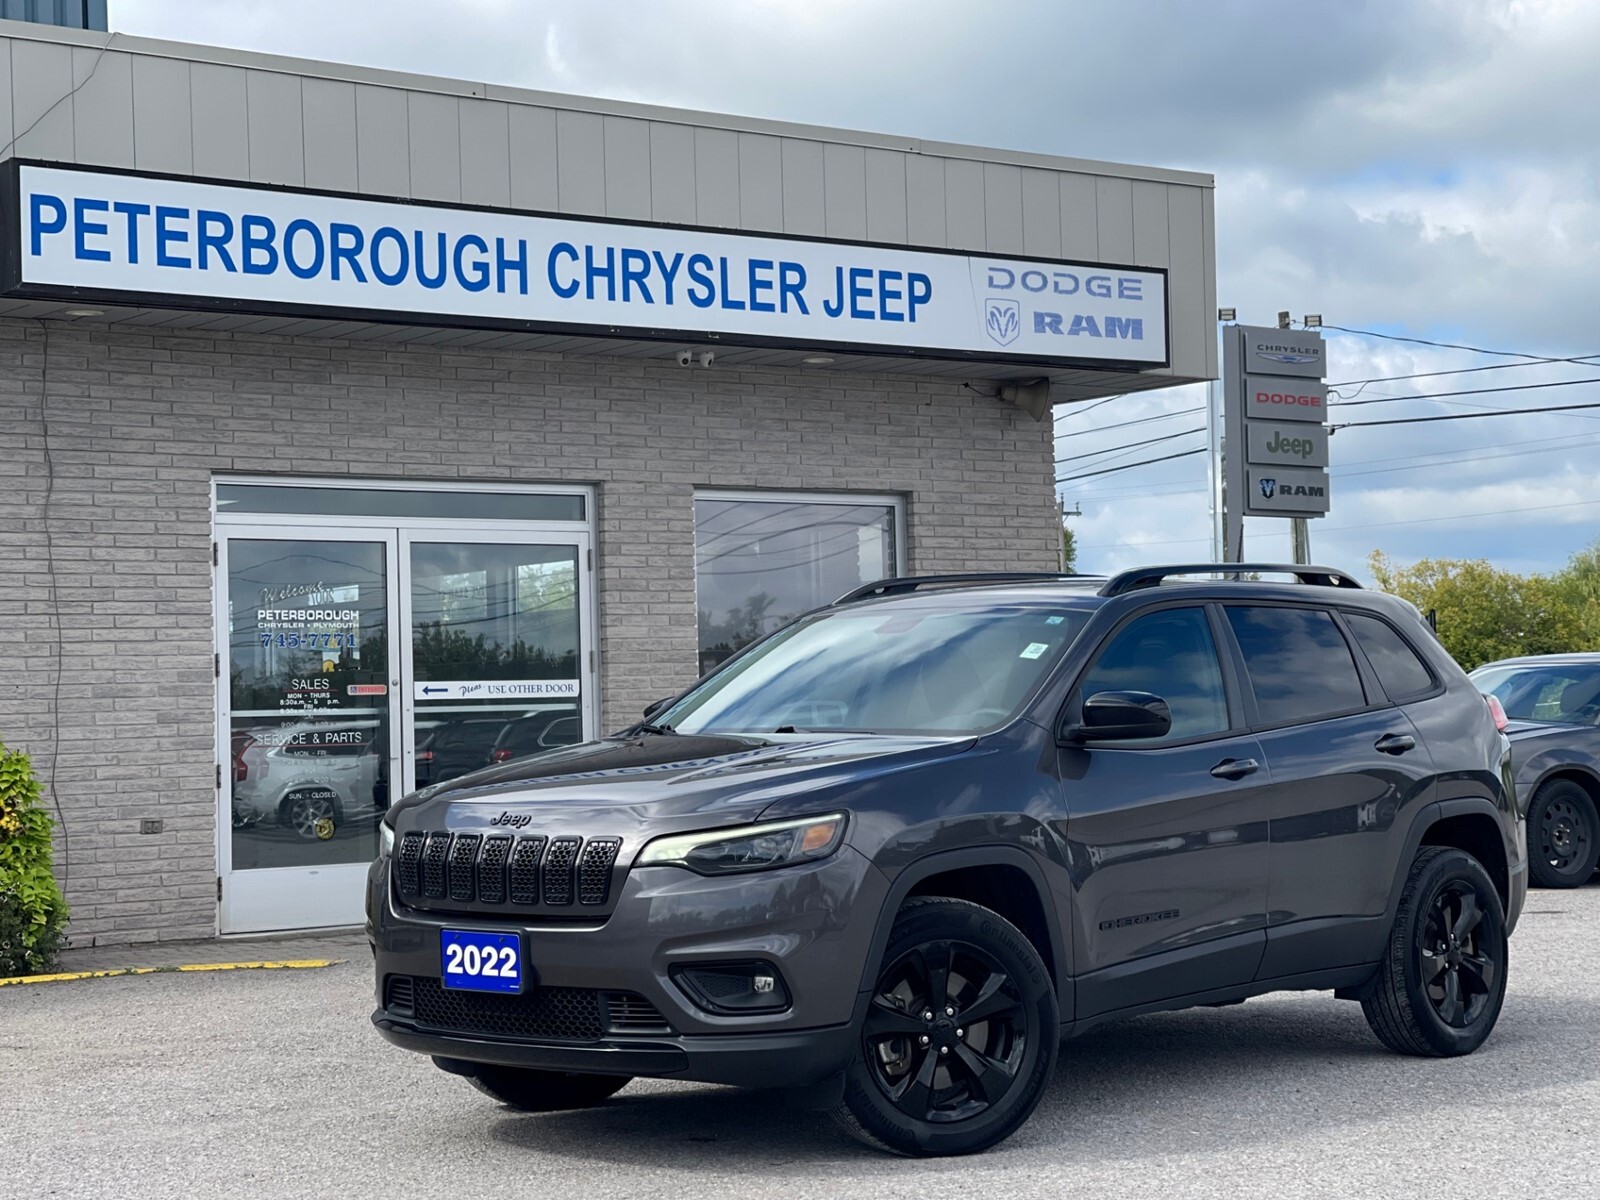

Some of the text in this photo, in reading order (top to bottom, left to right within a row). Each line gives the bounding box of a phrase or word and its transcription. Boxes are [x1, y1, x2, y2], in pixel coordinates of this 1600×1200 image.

[29, 193, 932, 323] PETERBOROUGH CHRYSLER JEEP
[987, 266, 1144, 301] DODGE
[1033, 311, 1144, 341] RAM
[1256, 343, 1320, 356] CHRYSLER
[1255, 392, 1322, 408] DODGE
[1266, 430, 1314, 460] Jeep
[1279, 484, 1325, 498] RAM
[260, 581, 325, 602] Welcome
[257, 609, 360, 621] PETERBOROUGH
[260, 632, 357, 649] 745-7771
[291, 678, 330, 690] SALES
[487, 685, 506, 694] USE
[508, 684, 544, 694] OTHER
[545, 683, 575, 694] DOOR
[256, 731, 362, 746] SERVICE & PARTS
[490, 811, 532, 828] Jeep
[1098, 908, 1180, 931] CHEROKEE
[446, 943, 518, 978] 2022
